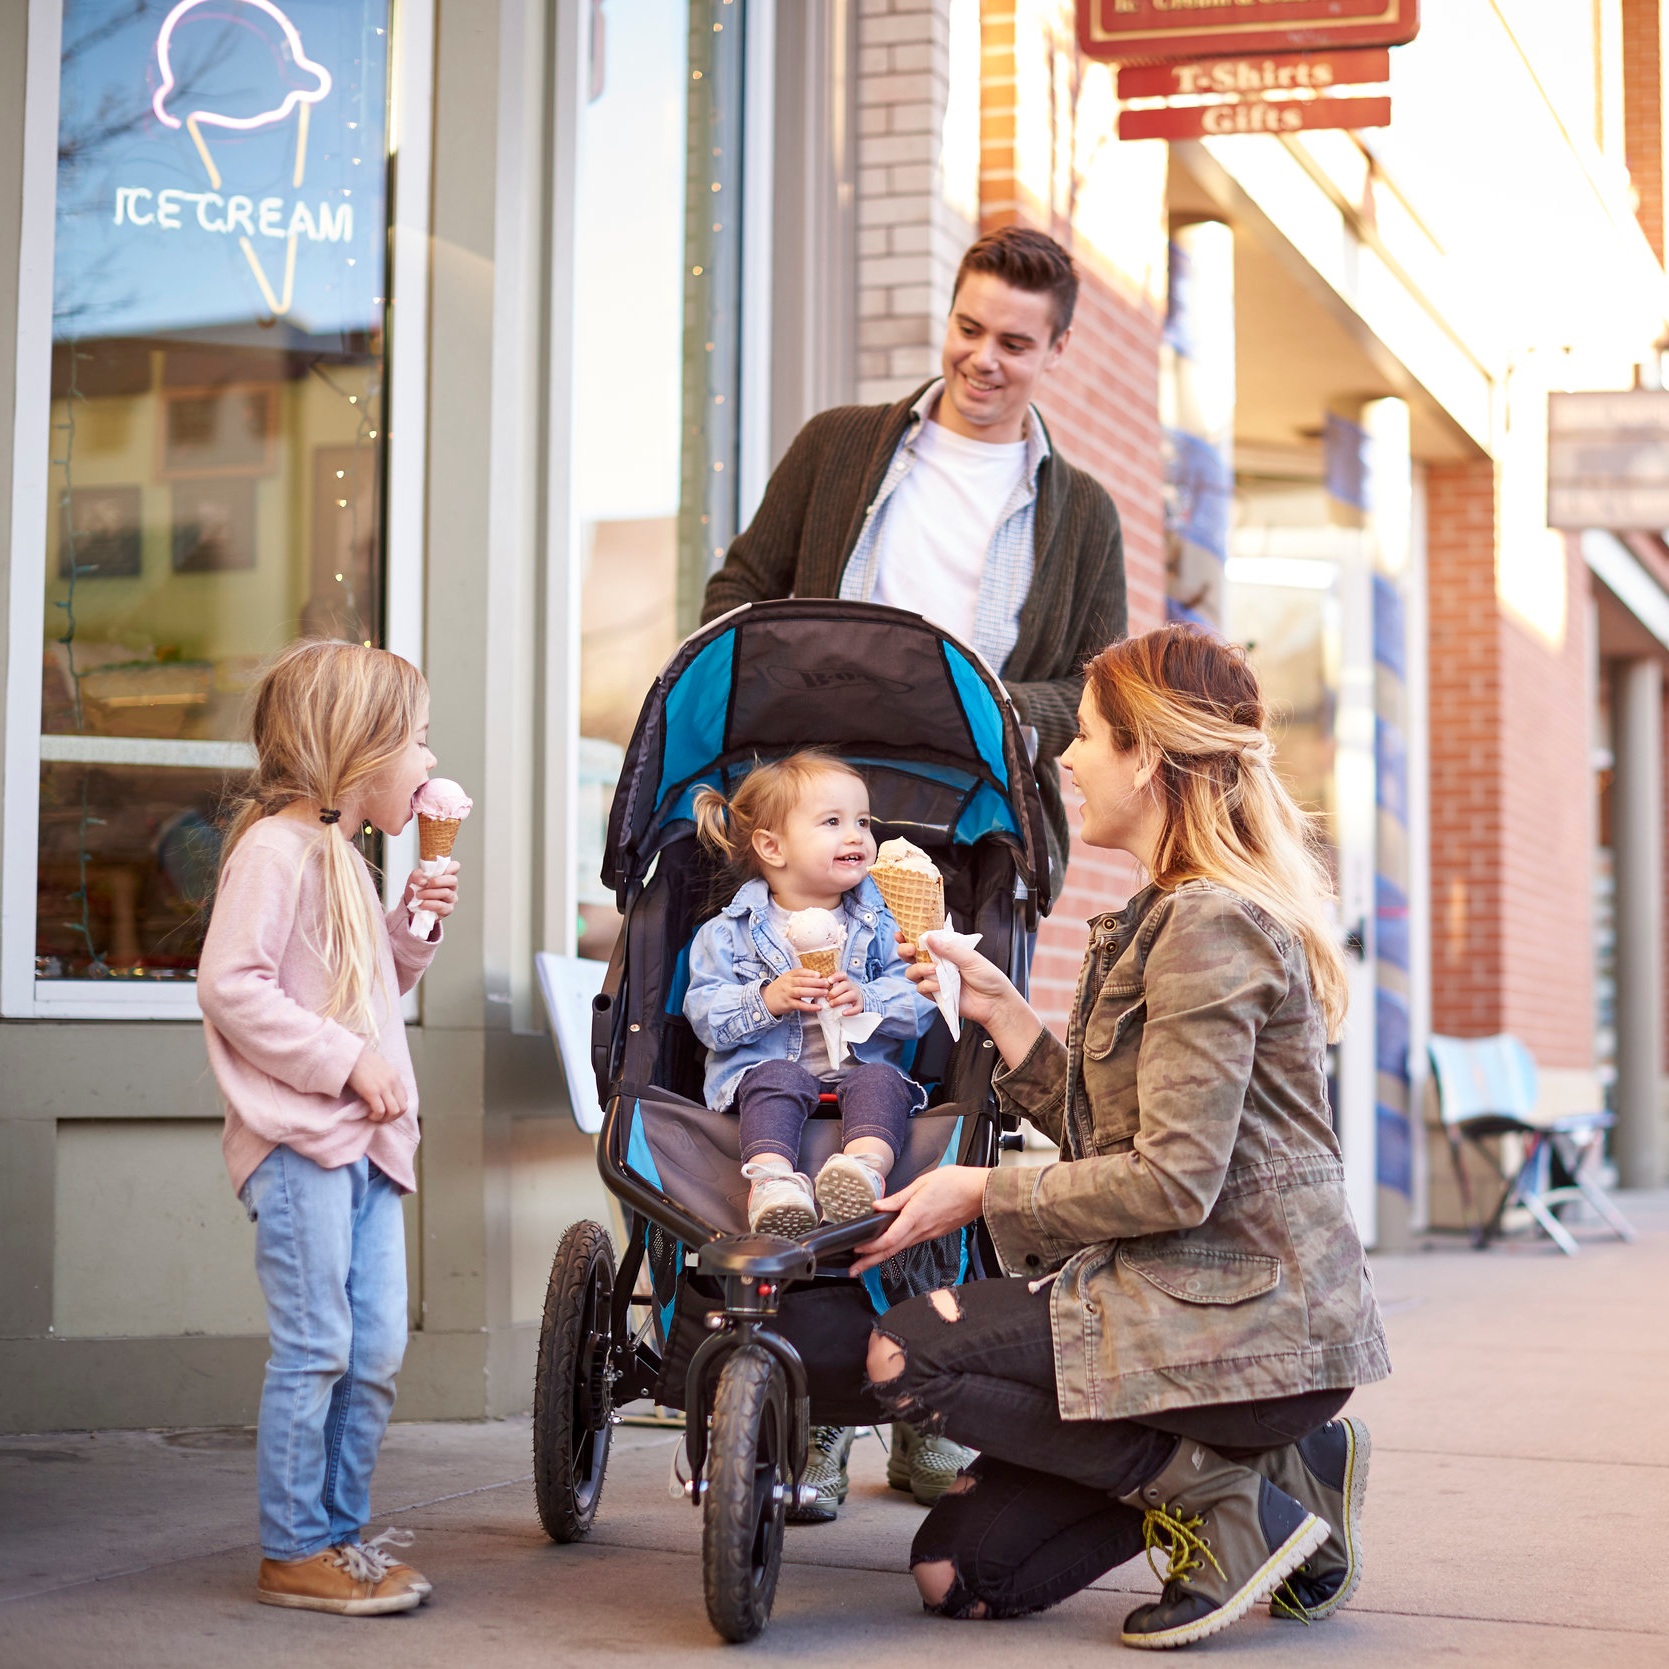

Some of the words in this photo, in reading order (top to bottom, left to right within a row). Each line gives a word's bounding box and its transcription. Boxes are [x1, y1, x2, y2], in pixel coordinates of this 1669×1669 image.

[1171, 60, 1333, 94] T-Shirts
[1202, 102, 1303, 134] Gifts
[113, 186, 182, 230] ICE
[196, 192, 354, 242] CREAM
